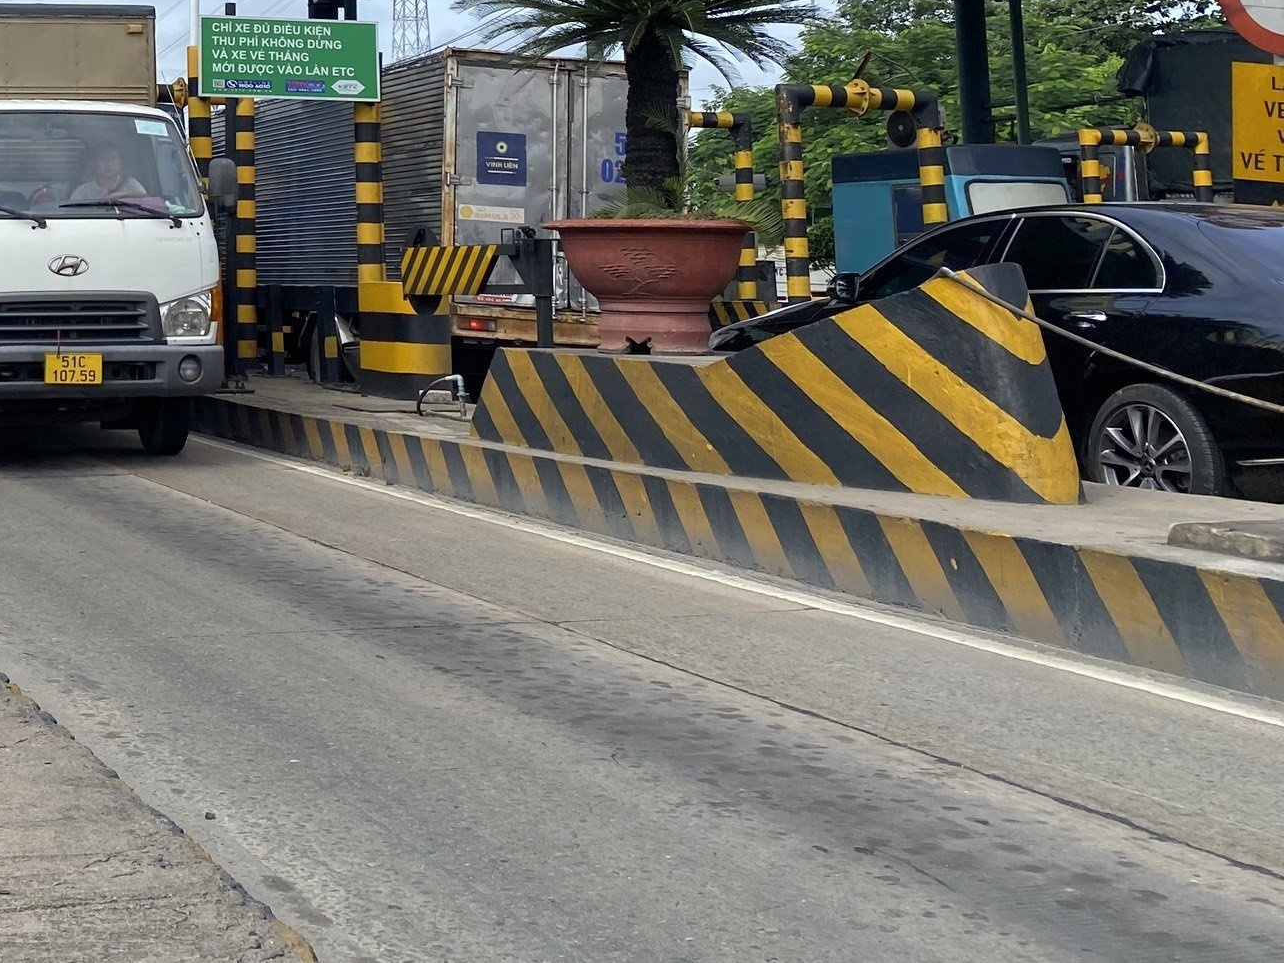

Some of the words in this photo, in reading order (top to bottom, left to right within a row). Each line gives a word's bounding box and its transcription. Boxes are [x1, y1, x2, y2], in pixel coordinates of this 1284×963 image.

[212, 22, 232, 33] CHỈ
[235, 23, 250, 33] XE
[253, 22, 270, 34] ĐỦ
[212, 36, 236, 46] THU
[239, 35, 259, 47] PHÍ
[262, 36, 304, 49] KHÔNG
[212, 48, 229, 59] VÀ
[231, 50, 247, 60] XE
[250, 49, 266, 60] VÉ
[269, 50, 310, 62] THÁNG
[212, 61, 235, 73] MỚI
[238, 63, 274, 76] ĐƯỢC
[277, 63, 303, 76] VÀO
[306, 64, 329, 76] LÀN
[332, 67, 355, 77] ETC
[1240, 149, 1265, 171] VÉ
[61, 355, 86, 368] 51C
[53, 370, 96, 382] 107.59
